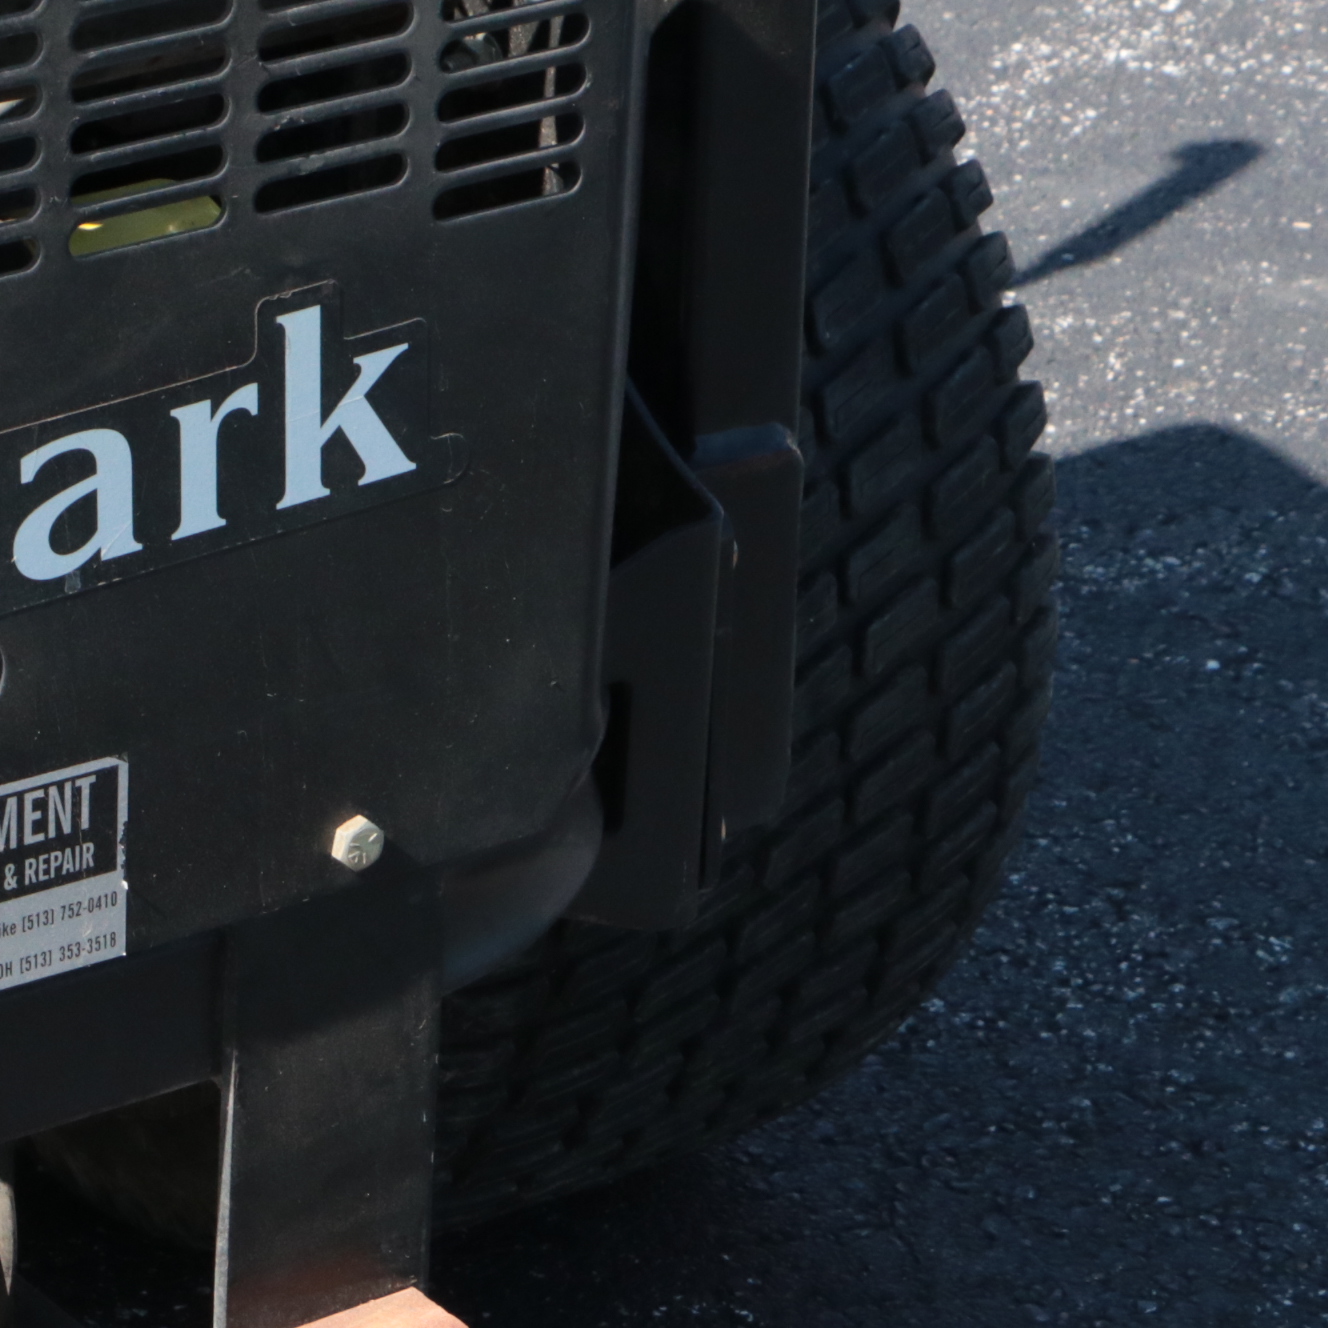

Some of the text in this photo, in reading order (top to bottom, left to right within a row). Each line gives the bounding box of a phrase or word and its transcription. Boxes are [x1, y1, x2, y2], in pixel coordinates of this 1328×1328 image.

[3, 862, 18, 890] &
[24, 841, 95, 886] REPAIR
[60, 891, 118, 920] 752-0410
[59, 931, 117, 962] 353-3518
